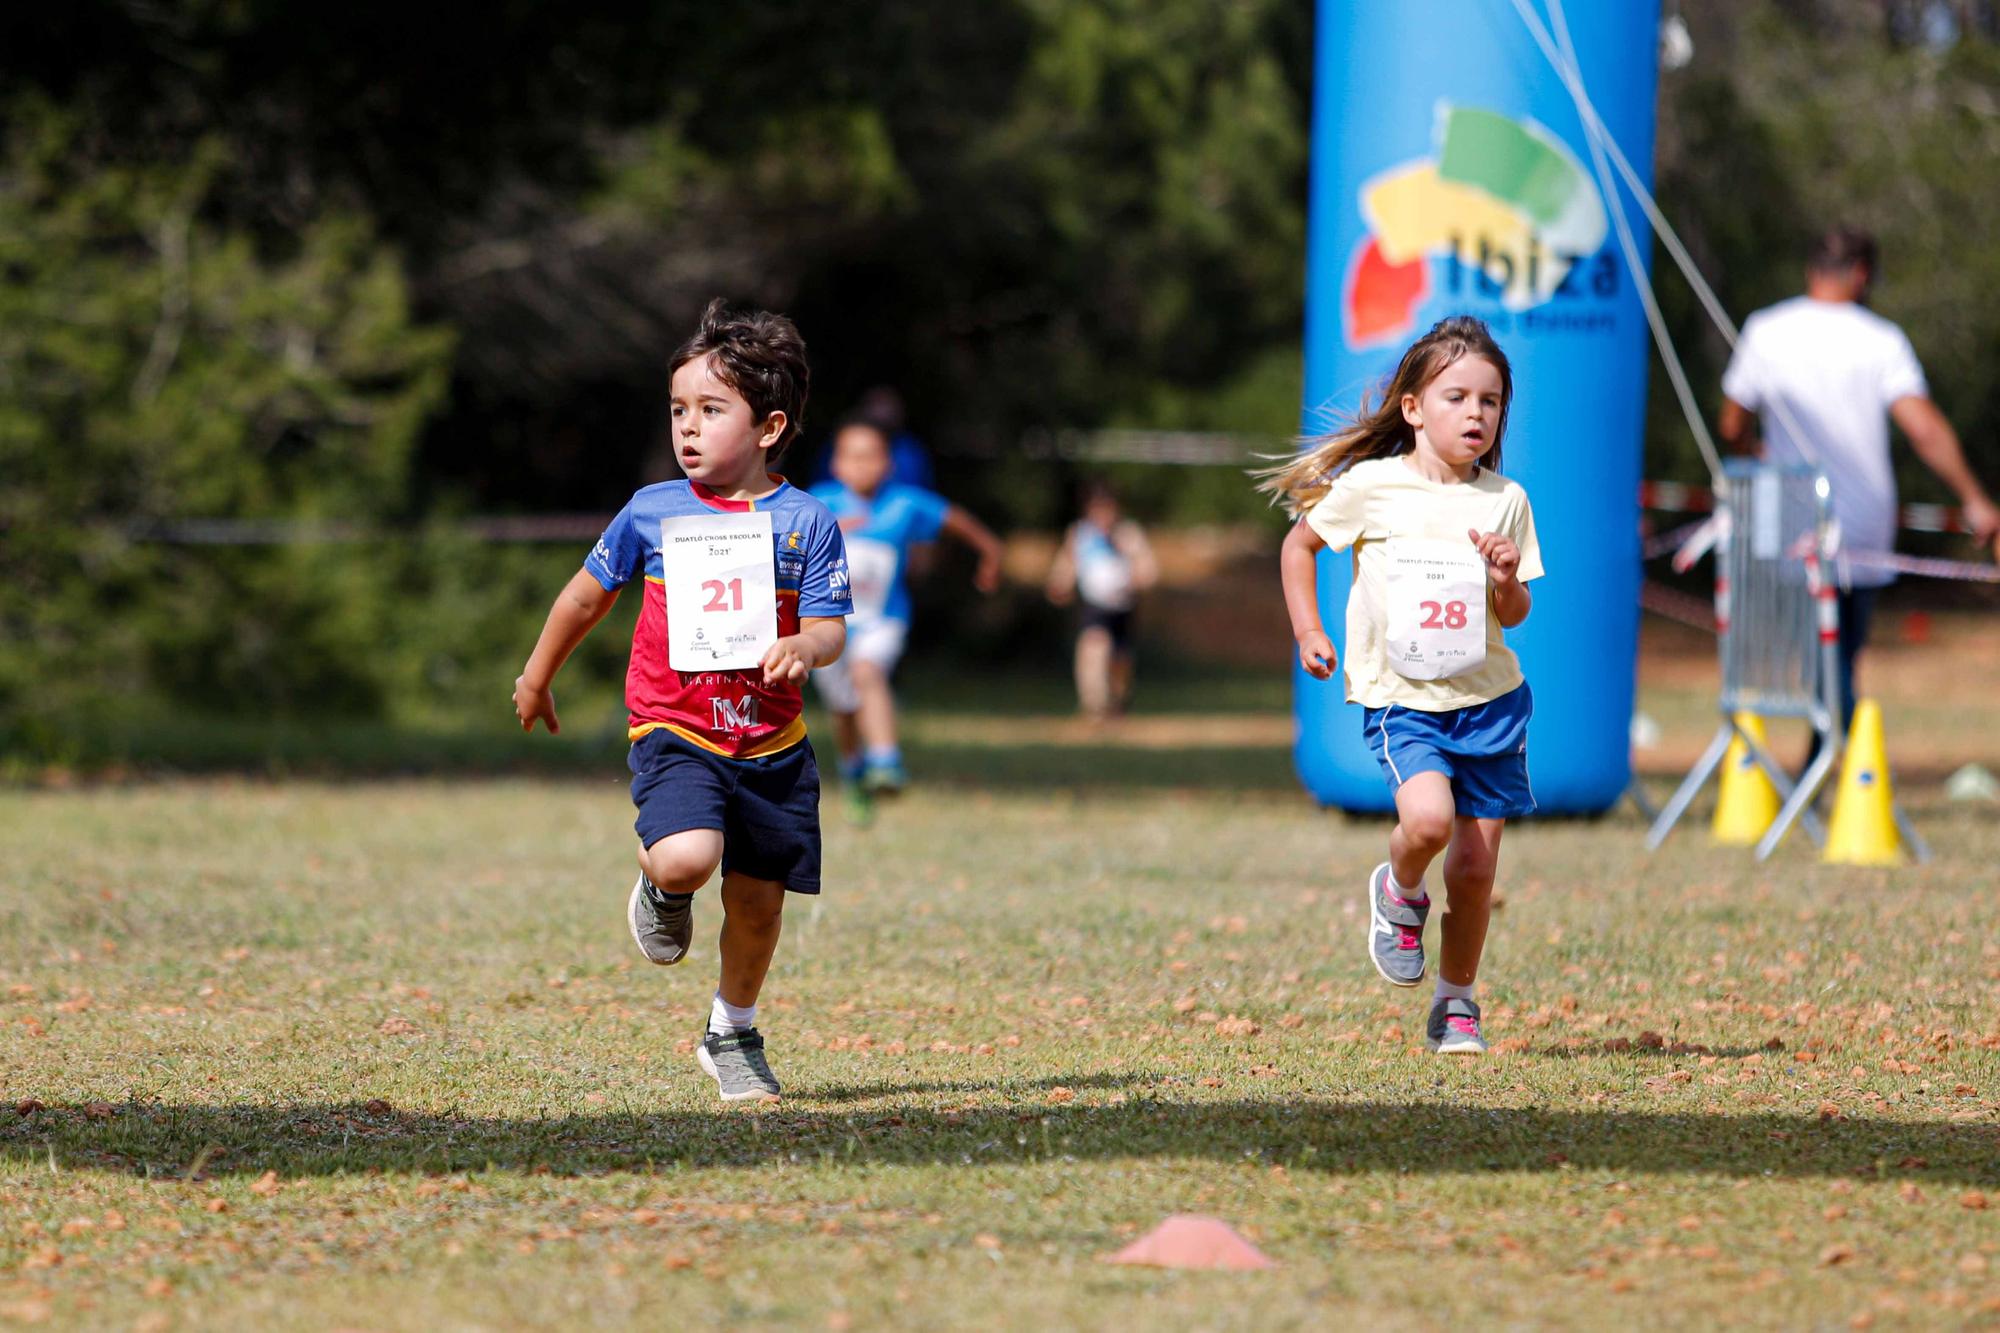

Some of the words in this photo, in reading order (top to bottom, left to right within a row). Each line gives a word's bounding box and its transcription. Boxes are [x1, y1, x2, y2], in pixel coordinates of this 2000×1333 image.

[1447, 227, 1619, 298] Ibiza
[708, 547, 730, 556] 2021
[701, 578, 743, 612] 21
[1419, 600, 1467, 630] 28
[684, 675, 742, 686] MARINA
